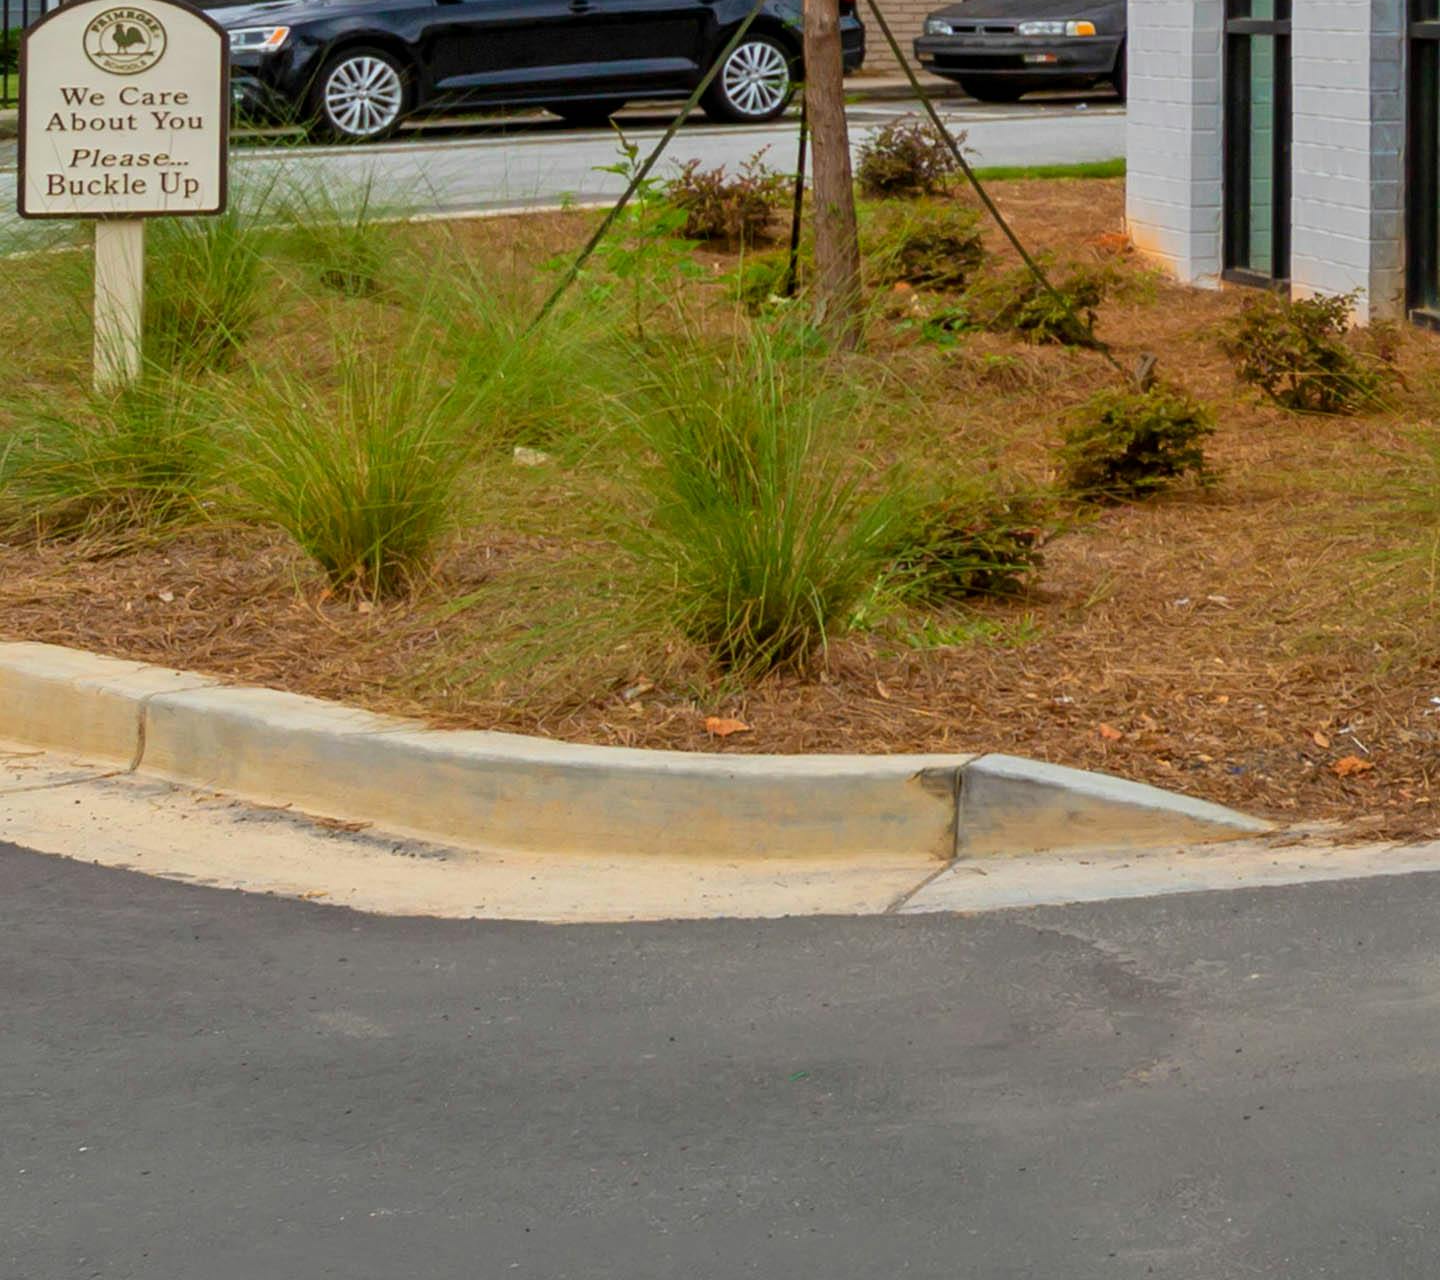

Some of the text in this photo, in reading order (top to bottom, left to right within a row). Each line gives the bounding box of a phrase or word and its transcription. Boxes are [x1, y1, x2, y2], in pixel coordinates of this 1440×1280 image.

[60, 86, 189, 106] We Care
[45, 111, 204, 132] About You
[69, 148, 189, 168] Please...
[46, 171, 200, 198] Buckle Up
